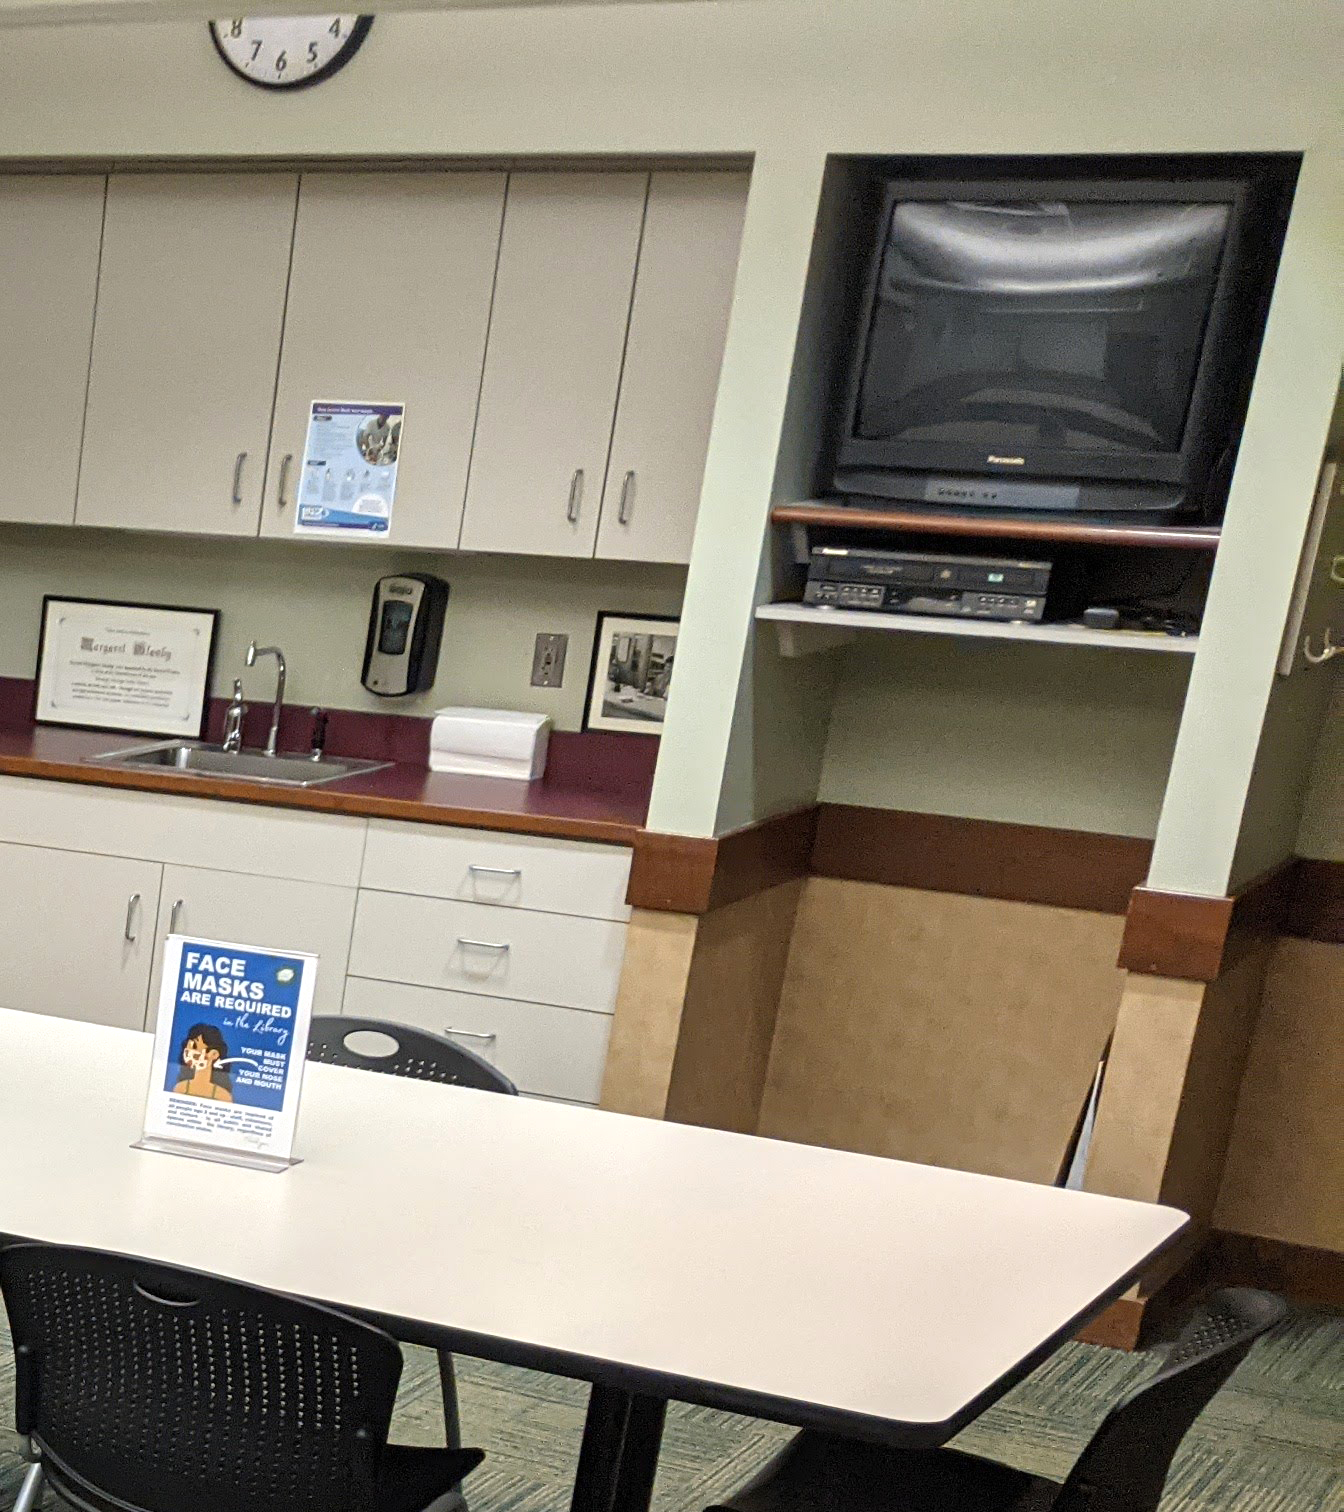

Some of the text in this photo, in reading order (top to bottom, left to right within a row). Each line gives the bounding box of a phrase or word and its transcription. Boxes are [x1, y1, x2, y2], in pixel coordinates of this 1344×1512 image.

[328, 17, 340, 38] 4
[251, 39, 263, 62] 7
[275, 50, 287, 72] 6
[306, 42, 318, 63] 5
[186, 952, 247, 977] FACE
[183, 971, 265, 1000] MASKS
[180, 990, 292, 1019] ARE REQUIRED
[223, 1012, 289, 1047] in the Library
[241, 1046, 287, 1061] YOUR MASK
[263, 1058, 286, 1068] MUST
[238, 1068, 284, 1083] YOUR NOSE
[257, 1065, 285, 1075] COVER
[235, 1076, 282, 1090] AND MOUTH
